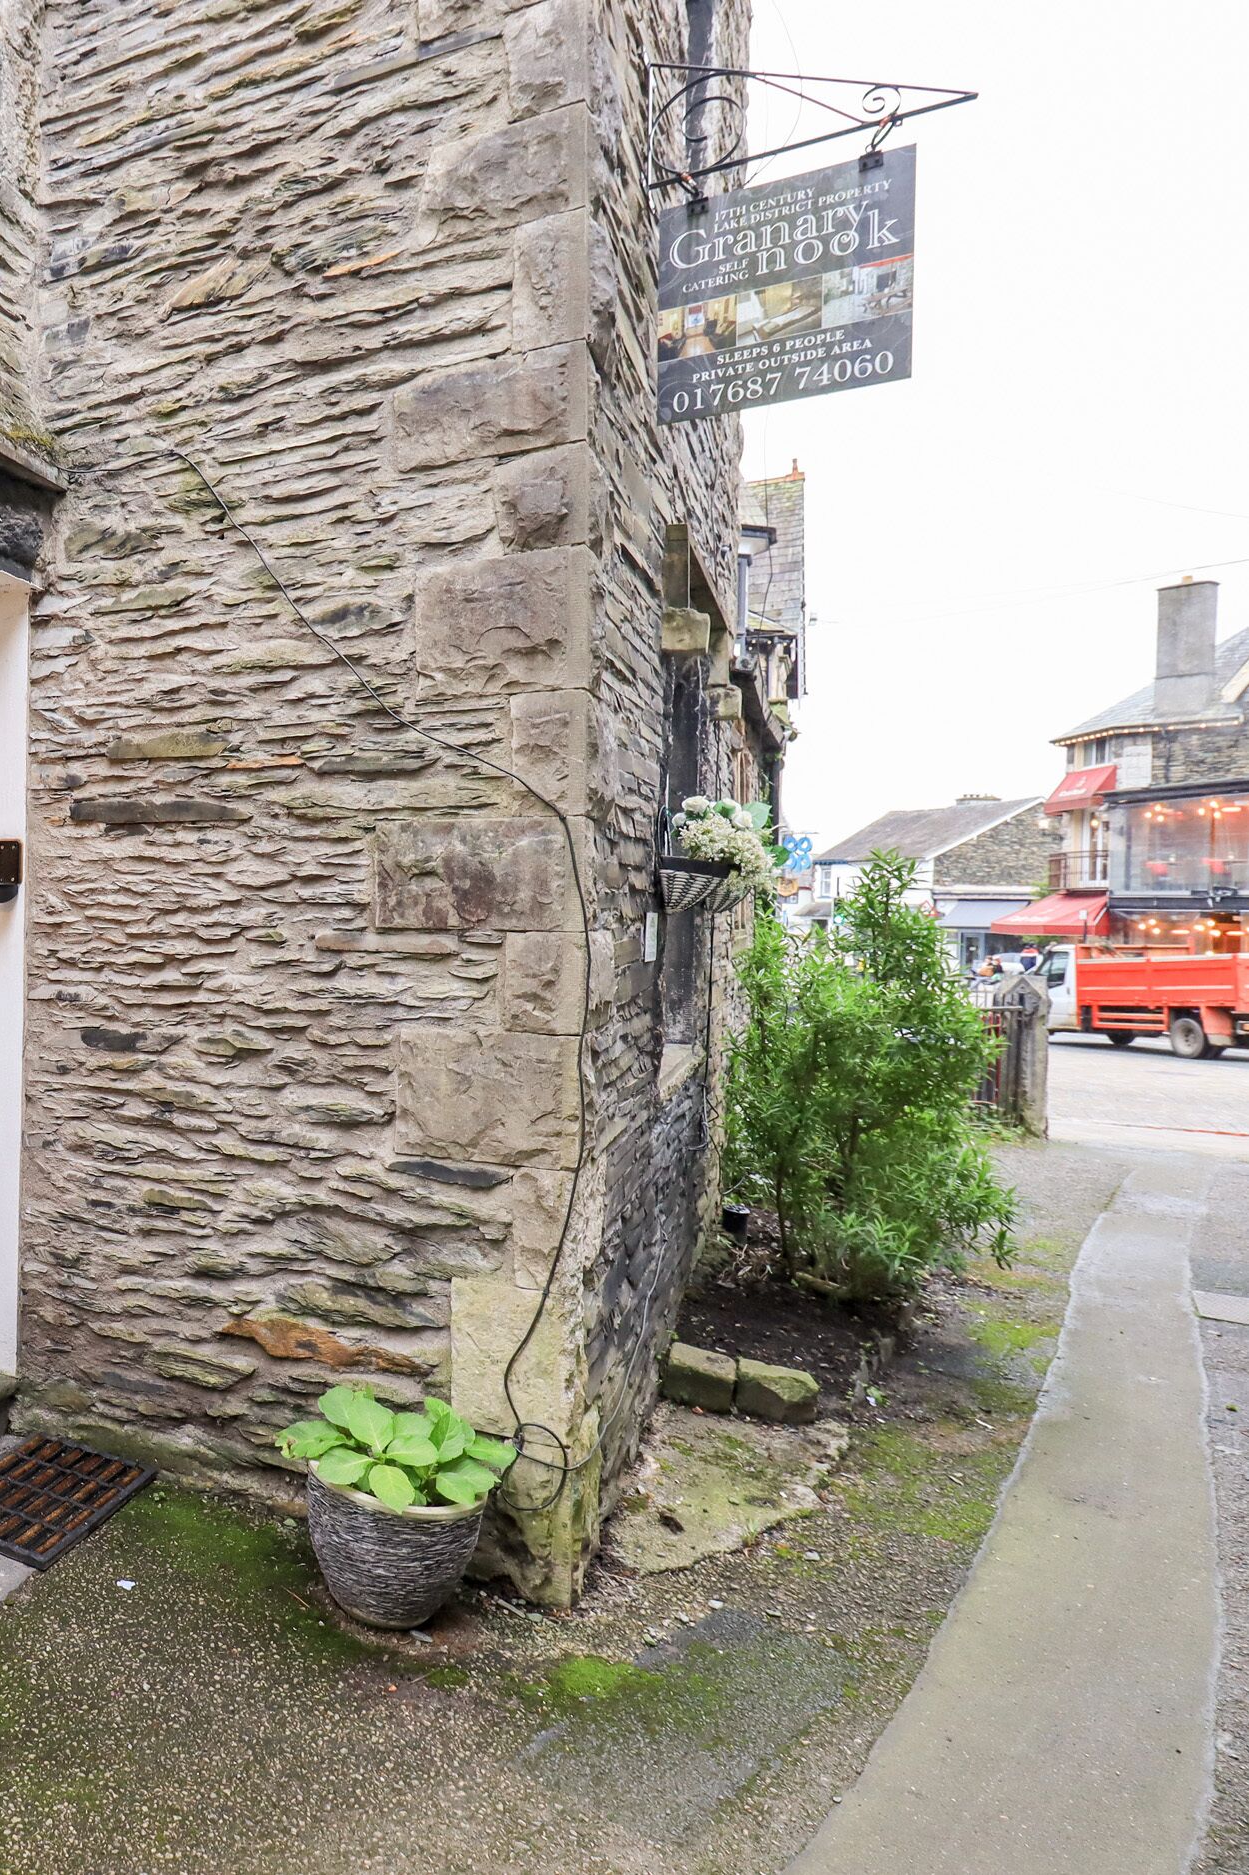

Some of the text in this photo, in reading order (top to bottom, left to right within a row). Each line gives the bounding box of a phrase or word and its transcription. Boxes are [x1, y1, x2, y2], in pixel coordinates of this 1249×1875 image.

[714, 178, 892, 233] LAKE DISTRICT PROPERTY
[715, 187, 815, 222] 17TH CENTURY
[669, 200, 869, 269] Granary
[755, 208, 901, 276] nook
[682, 270, 749, 293] CATERING
[719, 259, 749, 274] SELF
[692, 337, 872, 383] PRIVATE OUTSIDE AREA
[717, 329, 844, 365] SLEEPS 6 PEOPLE
[672, 350, 894, 413] 017687 74060
